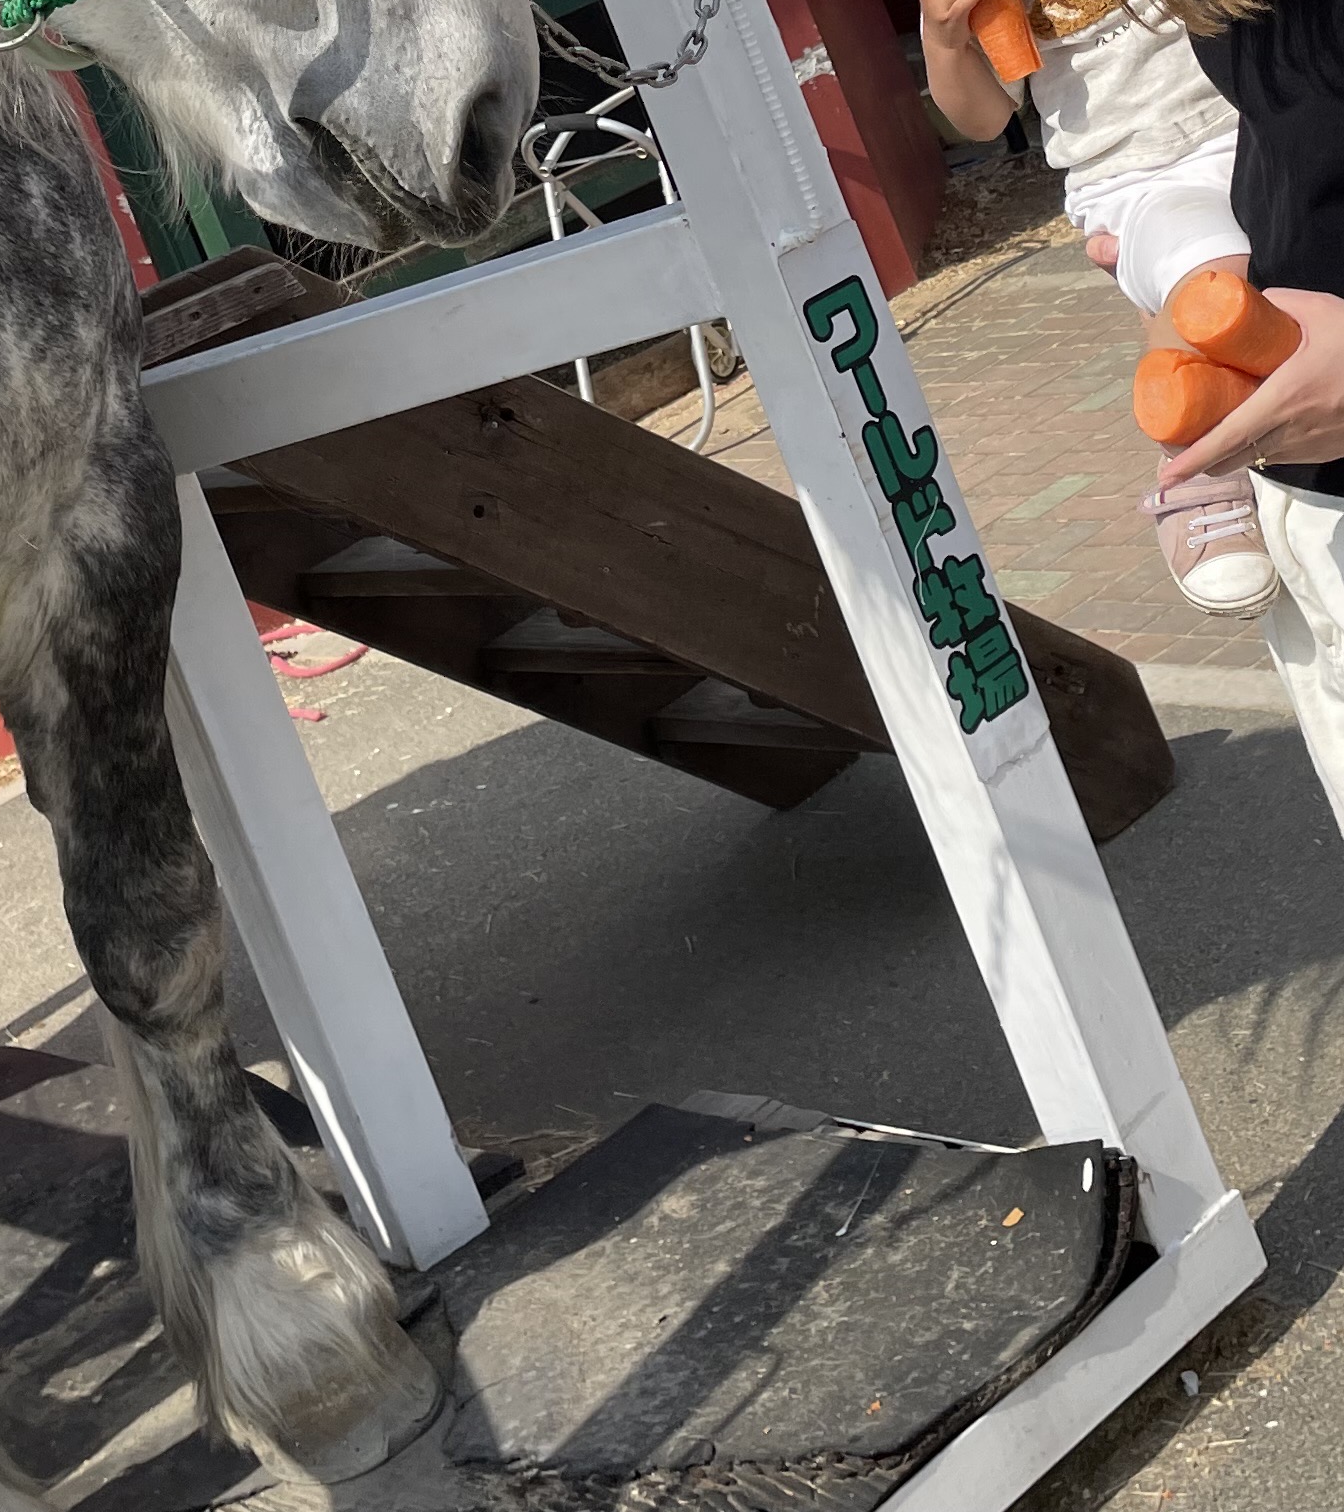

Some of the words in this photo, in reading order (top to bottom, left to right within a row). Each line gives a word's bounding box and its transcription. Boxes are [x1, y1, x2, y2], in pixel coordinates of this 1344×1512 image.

[802, 274, 1030, 735] ワールド牧場
